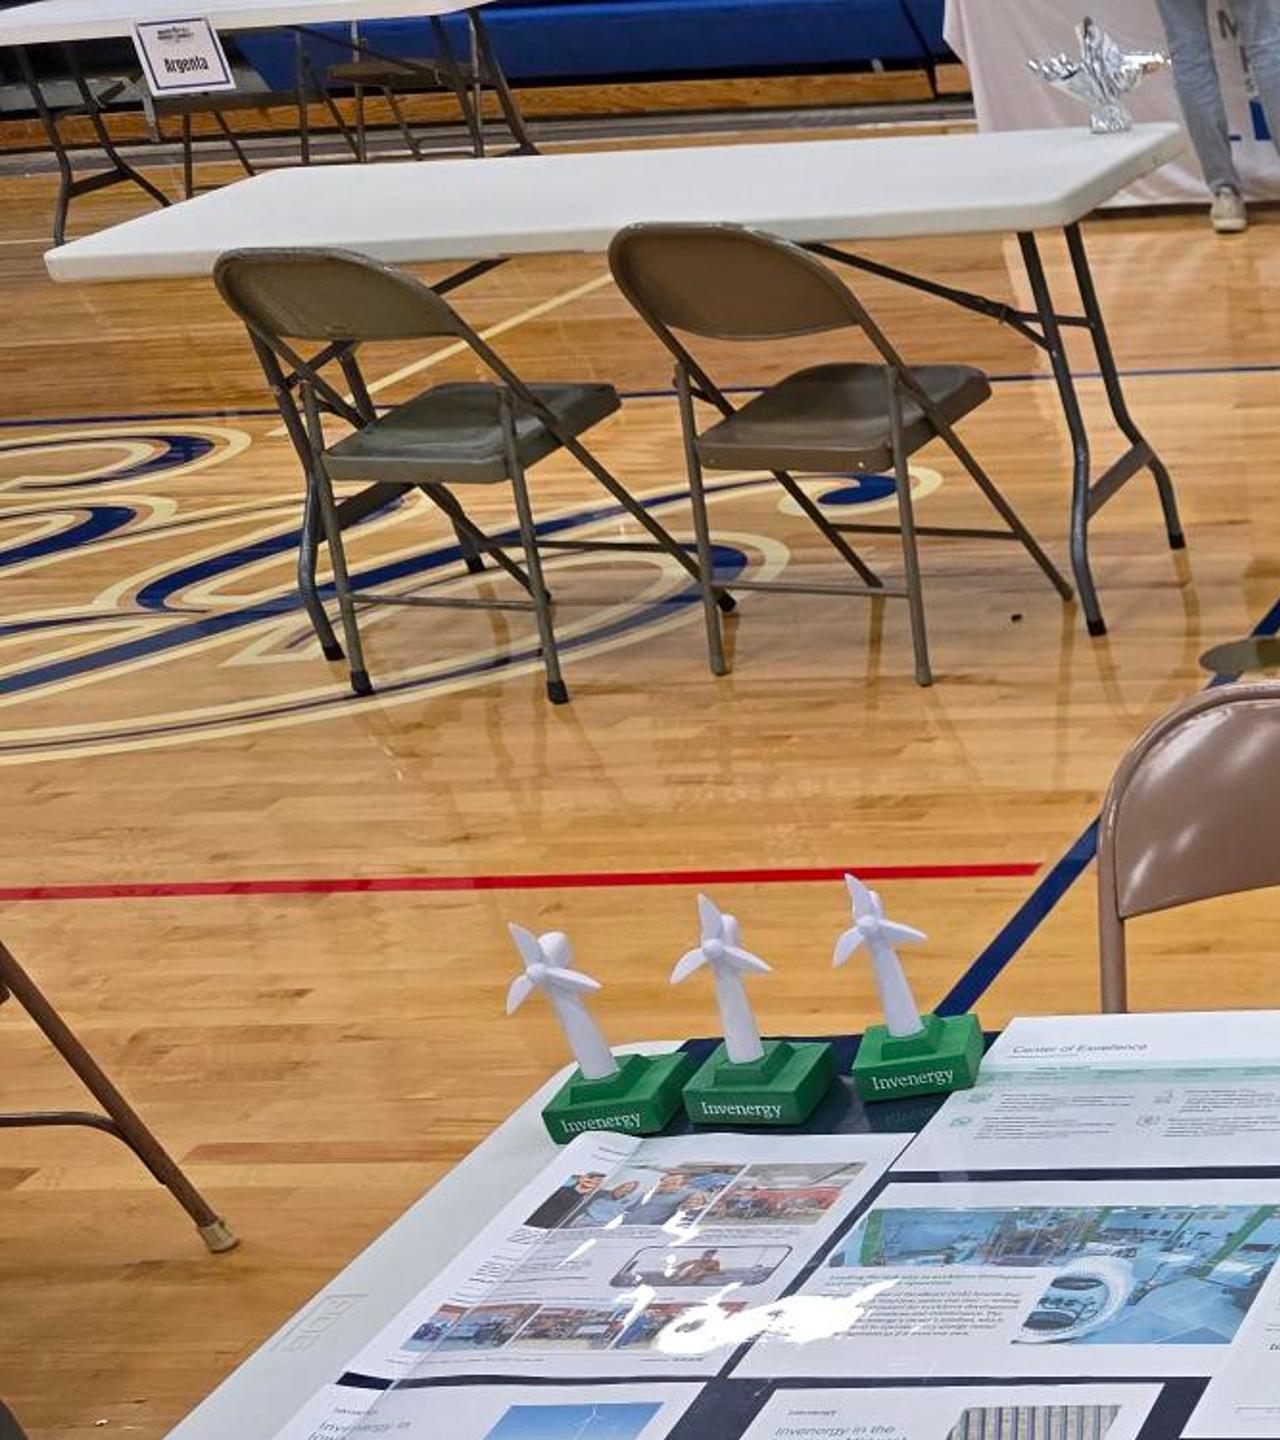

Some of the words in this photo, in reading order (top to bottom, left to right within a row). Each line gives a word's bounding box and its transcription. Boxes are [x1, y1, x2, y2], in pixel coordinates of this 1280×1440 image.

[164, 56, 209, 73] Argenta
[872, 1067, 953, 1091] Invenergy
[702, 1101, 783, 1118] Invenergy
[561, 1111, 641, 1133] Invenergy
[774, 1426, 845, 1438] Invenergy
[852, 1425, 868, 1435] in
[871, 1424, 896, 1434] the
